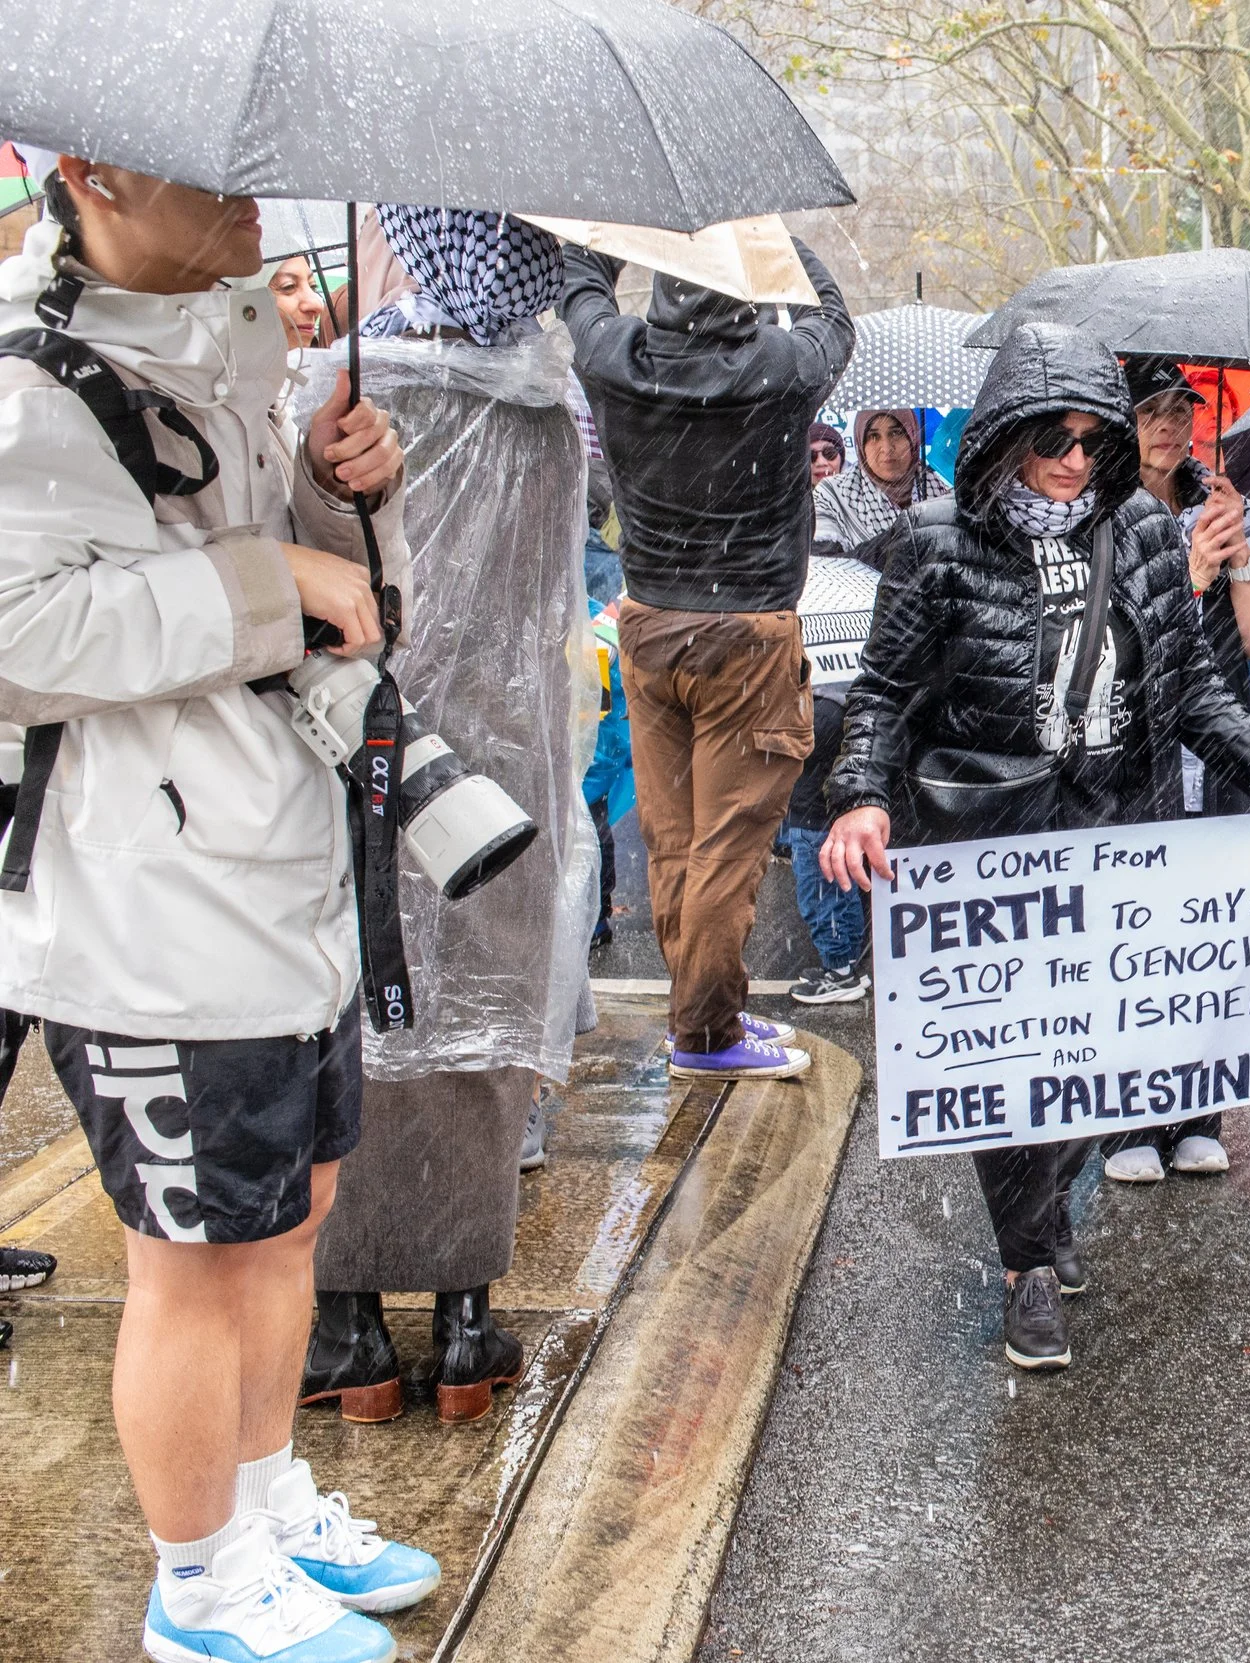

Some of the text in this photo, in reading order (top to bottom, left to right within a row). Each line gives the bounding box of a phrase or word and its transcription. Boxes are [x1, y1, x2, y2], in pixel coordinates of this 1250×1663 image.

[976, 846, 1075, 880] COME
[1094, 841, 1168, 872] FROM
[890, 885, 1086, 959] PERTH
[1111, 900, 1152, 930] TO
[918, 958, 1024, 1002] STOP
[1045, 957, 1092, 988] THE
[384, 984, 404, 1030] SON
[915, 1012, 1092, 1059] SANCTION
[1053, 1046, 1097, 1068] AND
[905, 1084, 1006, 1138] FREE
